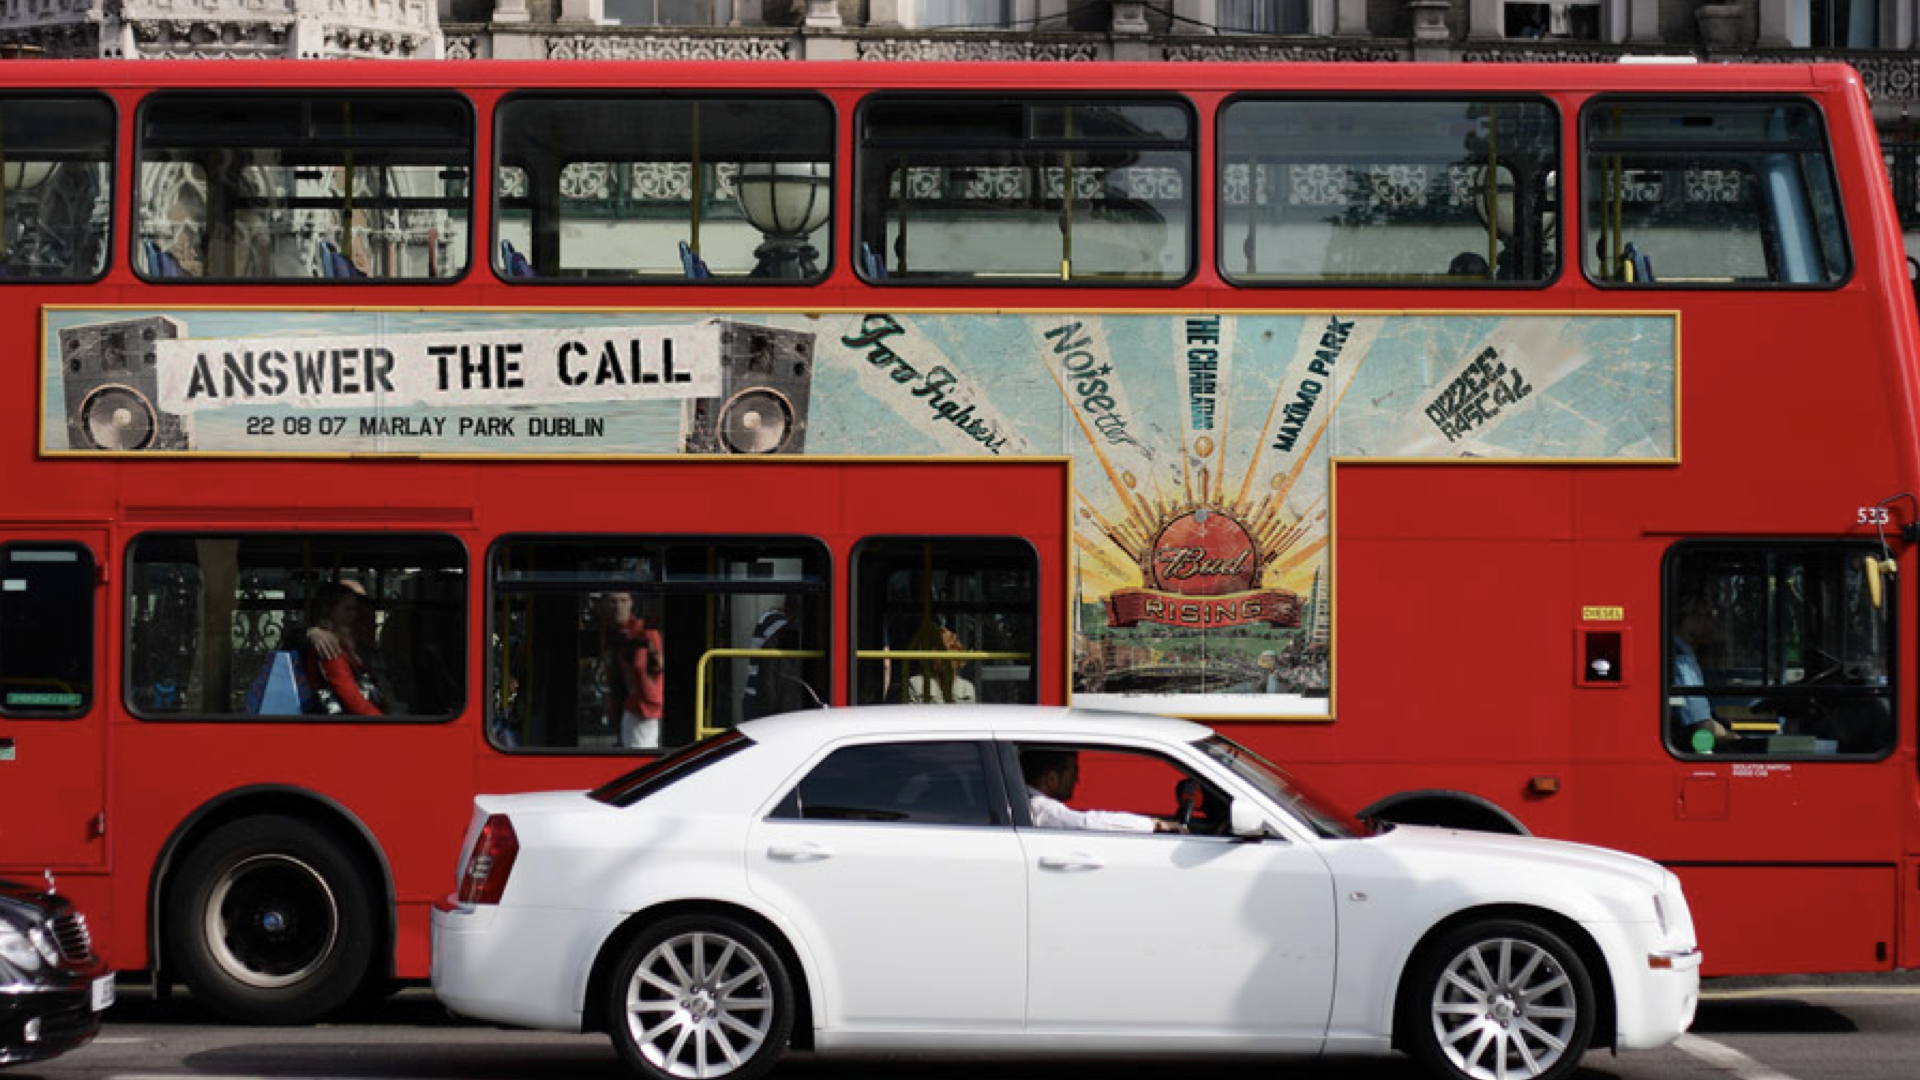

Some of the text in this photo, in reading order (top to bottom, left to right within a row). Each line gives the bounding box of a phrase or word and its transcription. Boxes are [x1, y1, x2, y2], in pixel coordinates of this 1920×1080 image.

[186, 338, 692, 398] ANSWER THE CALL
[841, 314, 924, 383] Foo
[1307, 314, 1354, 377] PARK
[246, 417, 604, 437] 22 08 07 MARLAY PARK DUBLIN
[1154, 547, 1250, 580] Bud
[1145, 600, 1261, 624] RISING
